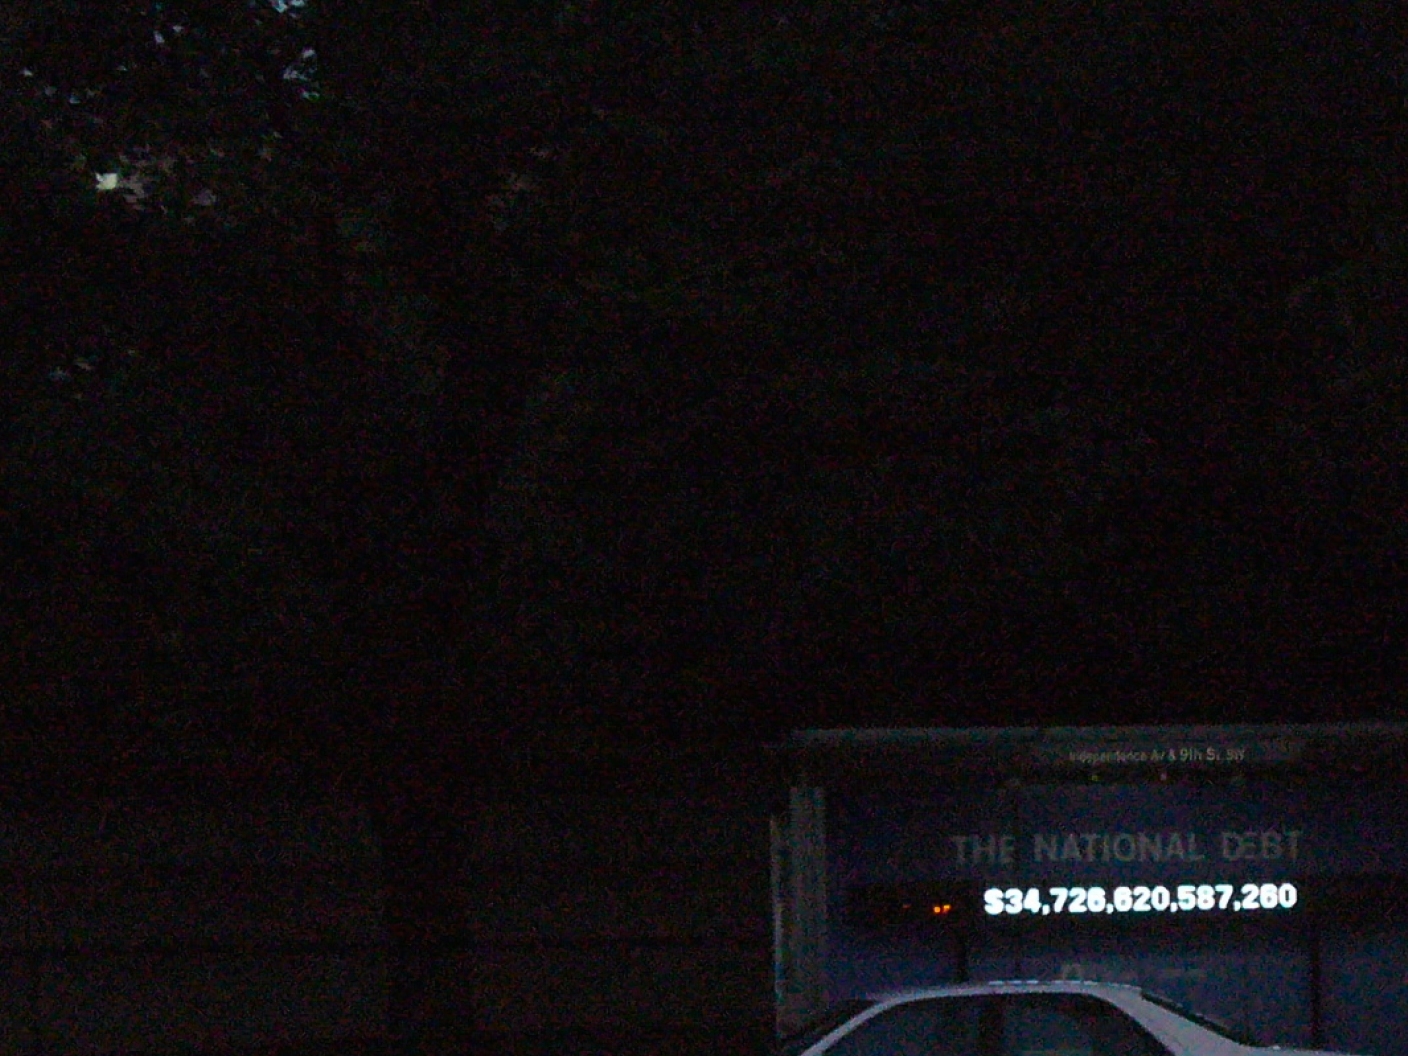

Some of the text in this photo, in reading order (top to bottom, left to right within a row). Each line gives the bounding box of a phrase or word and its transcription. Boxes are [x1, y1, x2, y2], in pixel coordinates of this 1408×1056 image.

[950, 828, 1303, 864] THE NATIONAL DEBT
